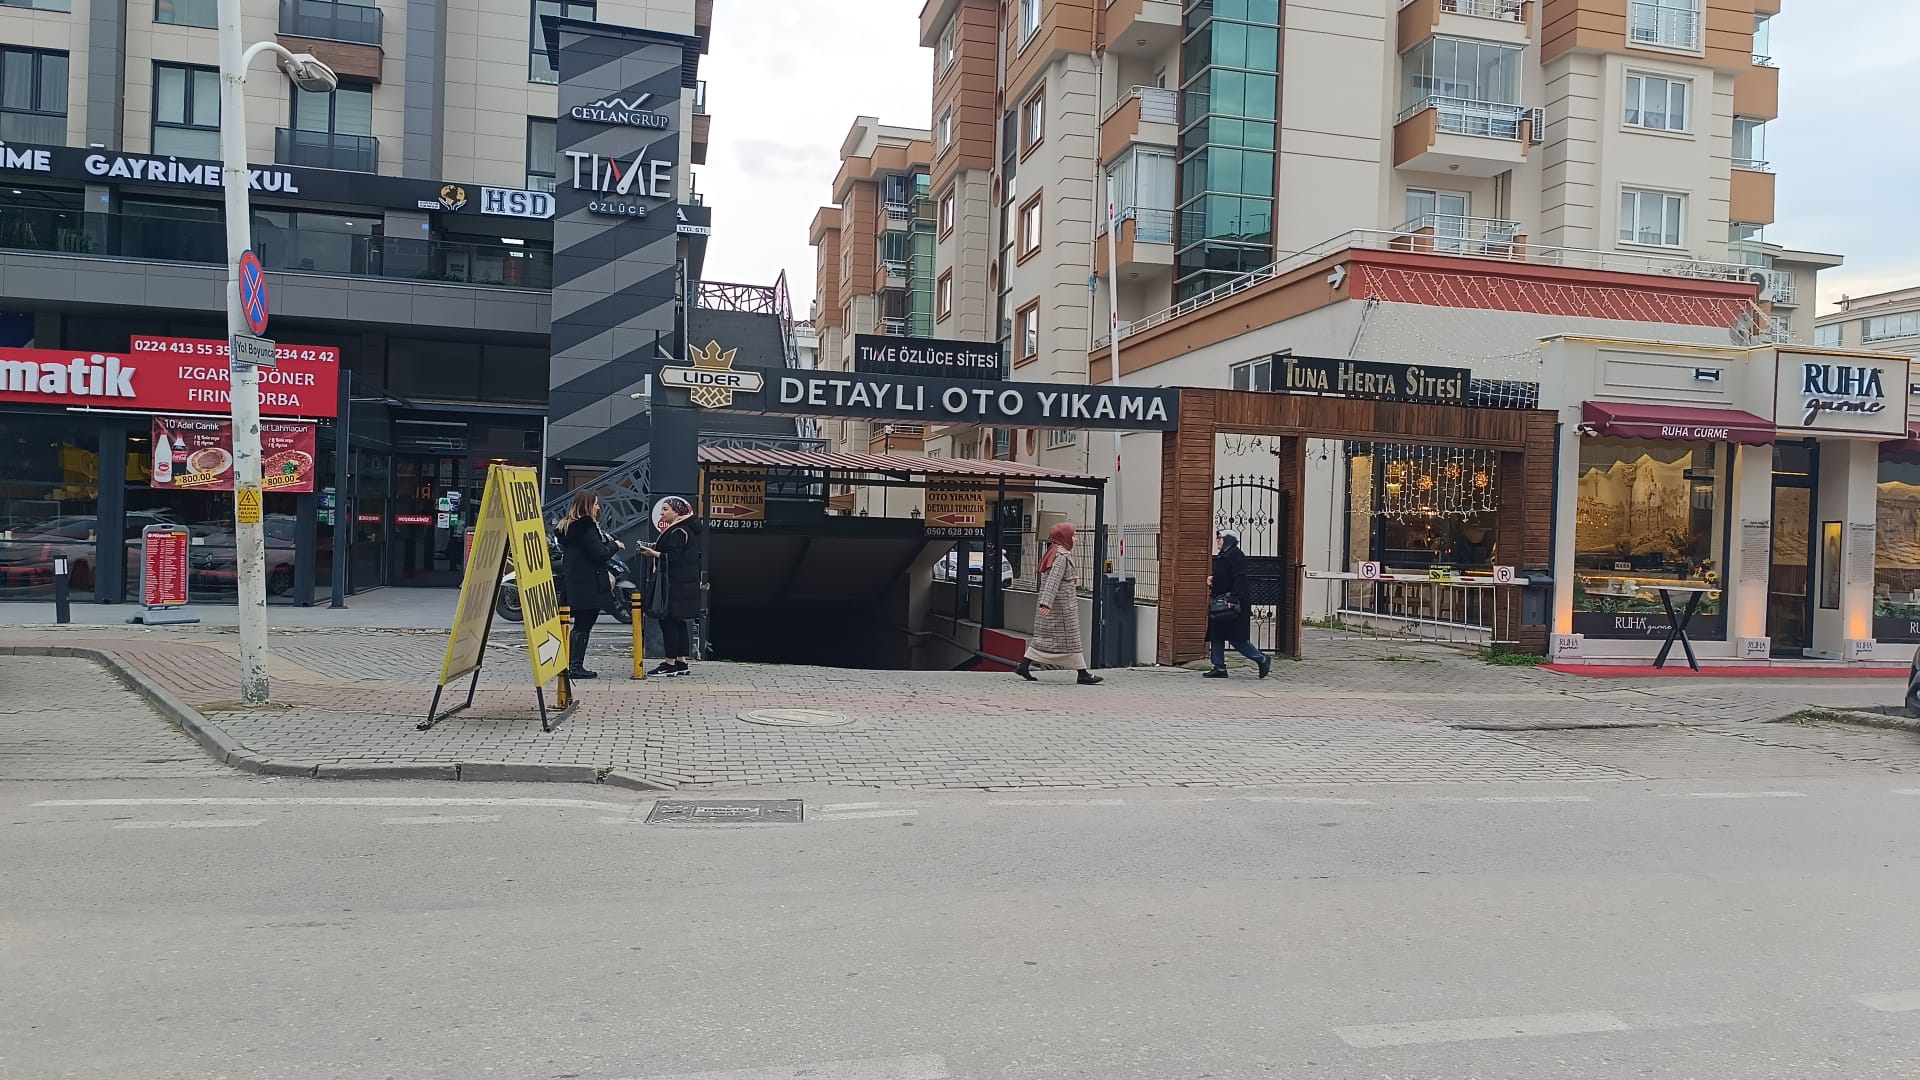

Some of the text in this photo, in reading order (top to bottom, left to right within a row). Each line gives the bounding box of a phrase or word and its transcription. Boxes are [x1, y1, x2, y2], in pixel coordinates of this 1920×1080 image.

[85, 155, 299, 193] GAYRİMEKUL
[565, 144, 672, 198] TIME
[485, 189, 549, 216] HSD
[589, 200, 646, 215] ÖZLÜCE
[134, 340, 335, 362] 0224 413 55 35 234 42 42
[237, 341, 275, 358] Yol Boyunca
[900, 346, 953, 365] ÖZLÜCE
[956, 350, 998, 369] SİTESİ
[0, 354, 137, 398] matik
[178, 366, 230, 381] IZGAR
[1283, 358, 1329, 390] TUNA
[1337, 361, 1396, 395] HERTA
[1803, 363, 1885, 398] RUHA
[188, 388, 300, 406] FIRIN ORBA
[780, 377, 1168, 422] DETAYLI OTO YIKAMA
[165, 419, 176, 429] 10
[1661, 426, 1729, 439] RUHA GURME
[182, 472, 211, 484] 800.00
[267, 474, 295, 486] 800.00
[711, 483, 761, 493] TO YIKAMA
[711, 494, 730, 504] TAYLI
[928, 493, 983, 502] OTO YIKAMA
[927, 503, 954, 513] DETAYLI
[723, 520, 739, 528] 628
[741, 520, 751, 528] 20
[926, 527, 945, 535] 0507
[947, 528, 962, 536] 628
[963, 528, 973, 536] 20
[522, 530, 544, 574] OTO
[525, 580, 559, 629] YIKAMA
[1615, 616, 1647, 630] RUHA
